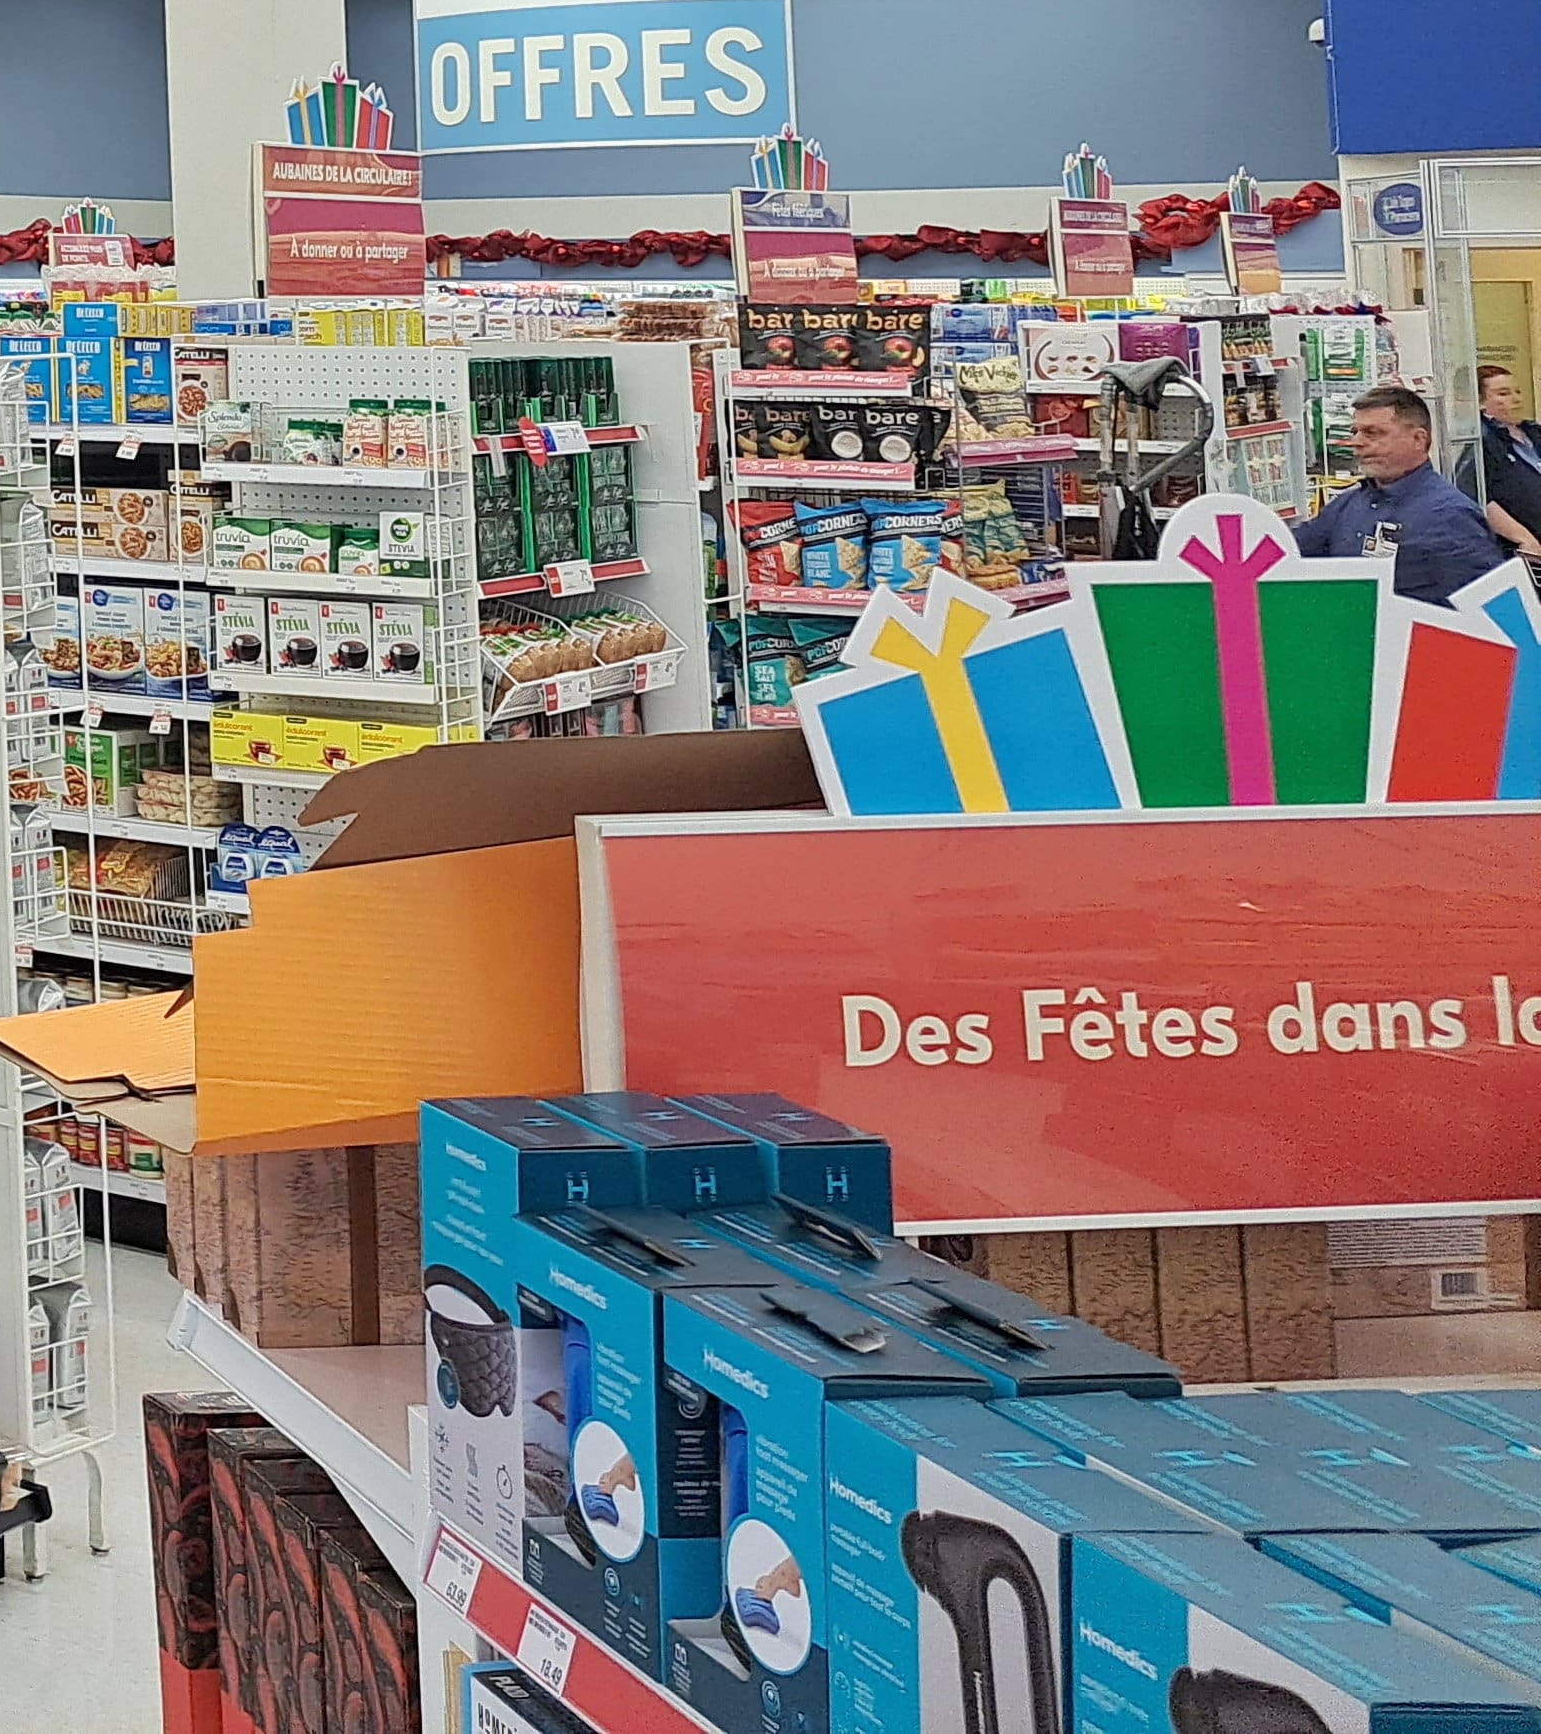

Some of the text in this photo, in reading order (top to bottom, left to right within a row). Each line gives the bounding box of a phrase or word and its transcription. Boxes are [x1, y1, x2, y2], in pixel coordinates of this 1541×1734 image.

[431, 27, 766, 127] OFFRES
[273, 162, 323, 181] AUBAINES
[325, 166, 338, 182] DE
[340, 167, 353, 183] LA
[302, 240, 337, 258] donner
[341, 247, 353, 258] ou
[356, 241, 365, 259] à
[366, 243, 408, 263] partager
[865, 310, 923, 331] bare
[175, 349, 210, 360] CATELLI
[865, 407, 920, 425] bare
[215, 531, 250, 544] truvía
[273, 534, 309, 547] truvía
[389, 544, 415, 554] STEVIA
[222, 612, 254, 628] STÉVIA
[276, 615, 310, 631] STÉVIA
[327, 618, 360, 635] STÉVIA
[379, 620, 412, 636] STÉVIA
[841, 995, 994, 1068] Des
[1022, 987, 1235, 1062] Fêtes
[1266, 980, 1467, 1052] dans
[549, 1267, 607, 1310] Homedics
[703, 1347, 769, 1399] Homedics
[829, 1476, 893, 1526] Homedics
[446, 1581, 468, 1608] 63.99
[1079, 1618, 1158, 1681] Homedics
[540, 1658, 563, 1686] 18.49
